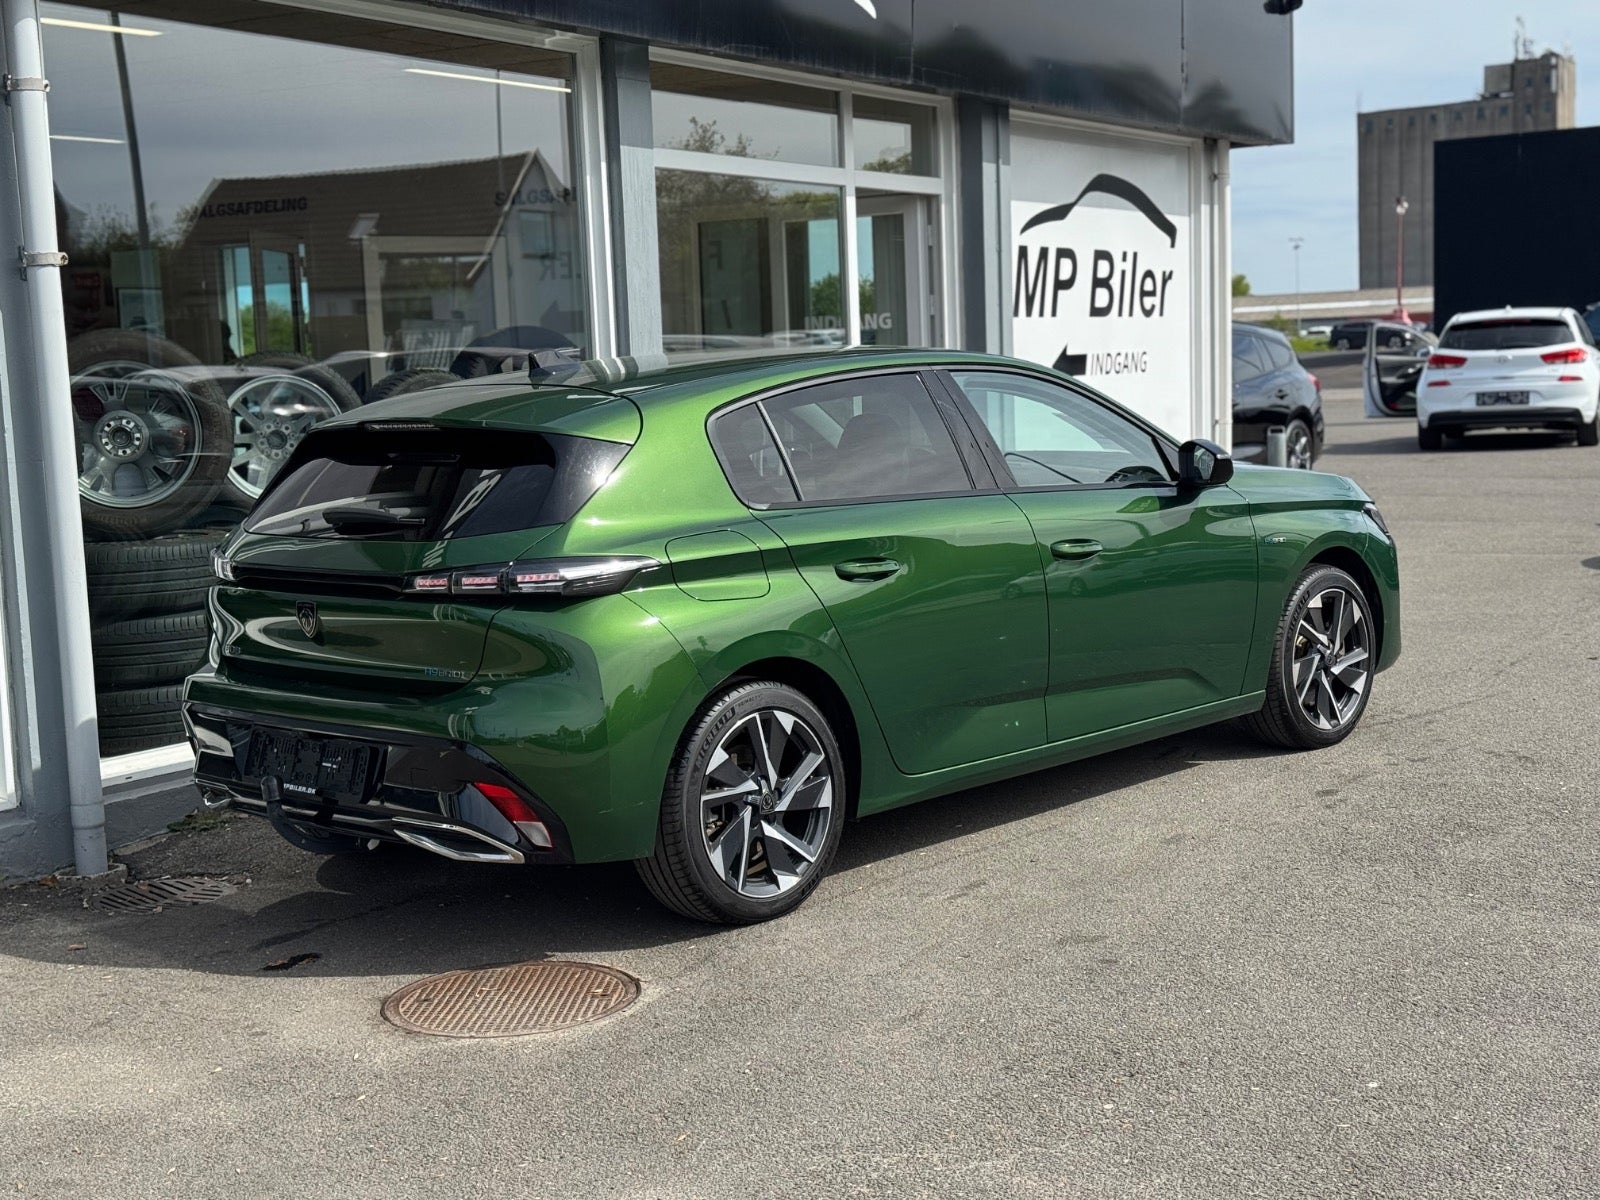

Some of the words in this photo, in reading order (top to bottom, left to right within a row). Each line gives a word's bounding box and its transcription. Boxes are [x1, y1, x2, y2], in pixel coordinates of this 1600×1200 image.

[197, 197, 308, 219] ALGSAFDELING
[1013, 245, 1078, 318] MP
[1089, 249, 1173, 318] Biler
[804, 312, 893, 331] INDNG
[1090, 351, 1148, 376] INDGANG
[695, 708, 735, 770] MICHELIN
